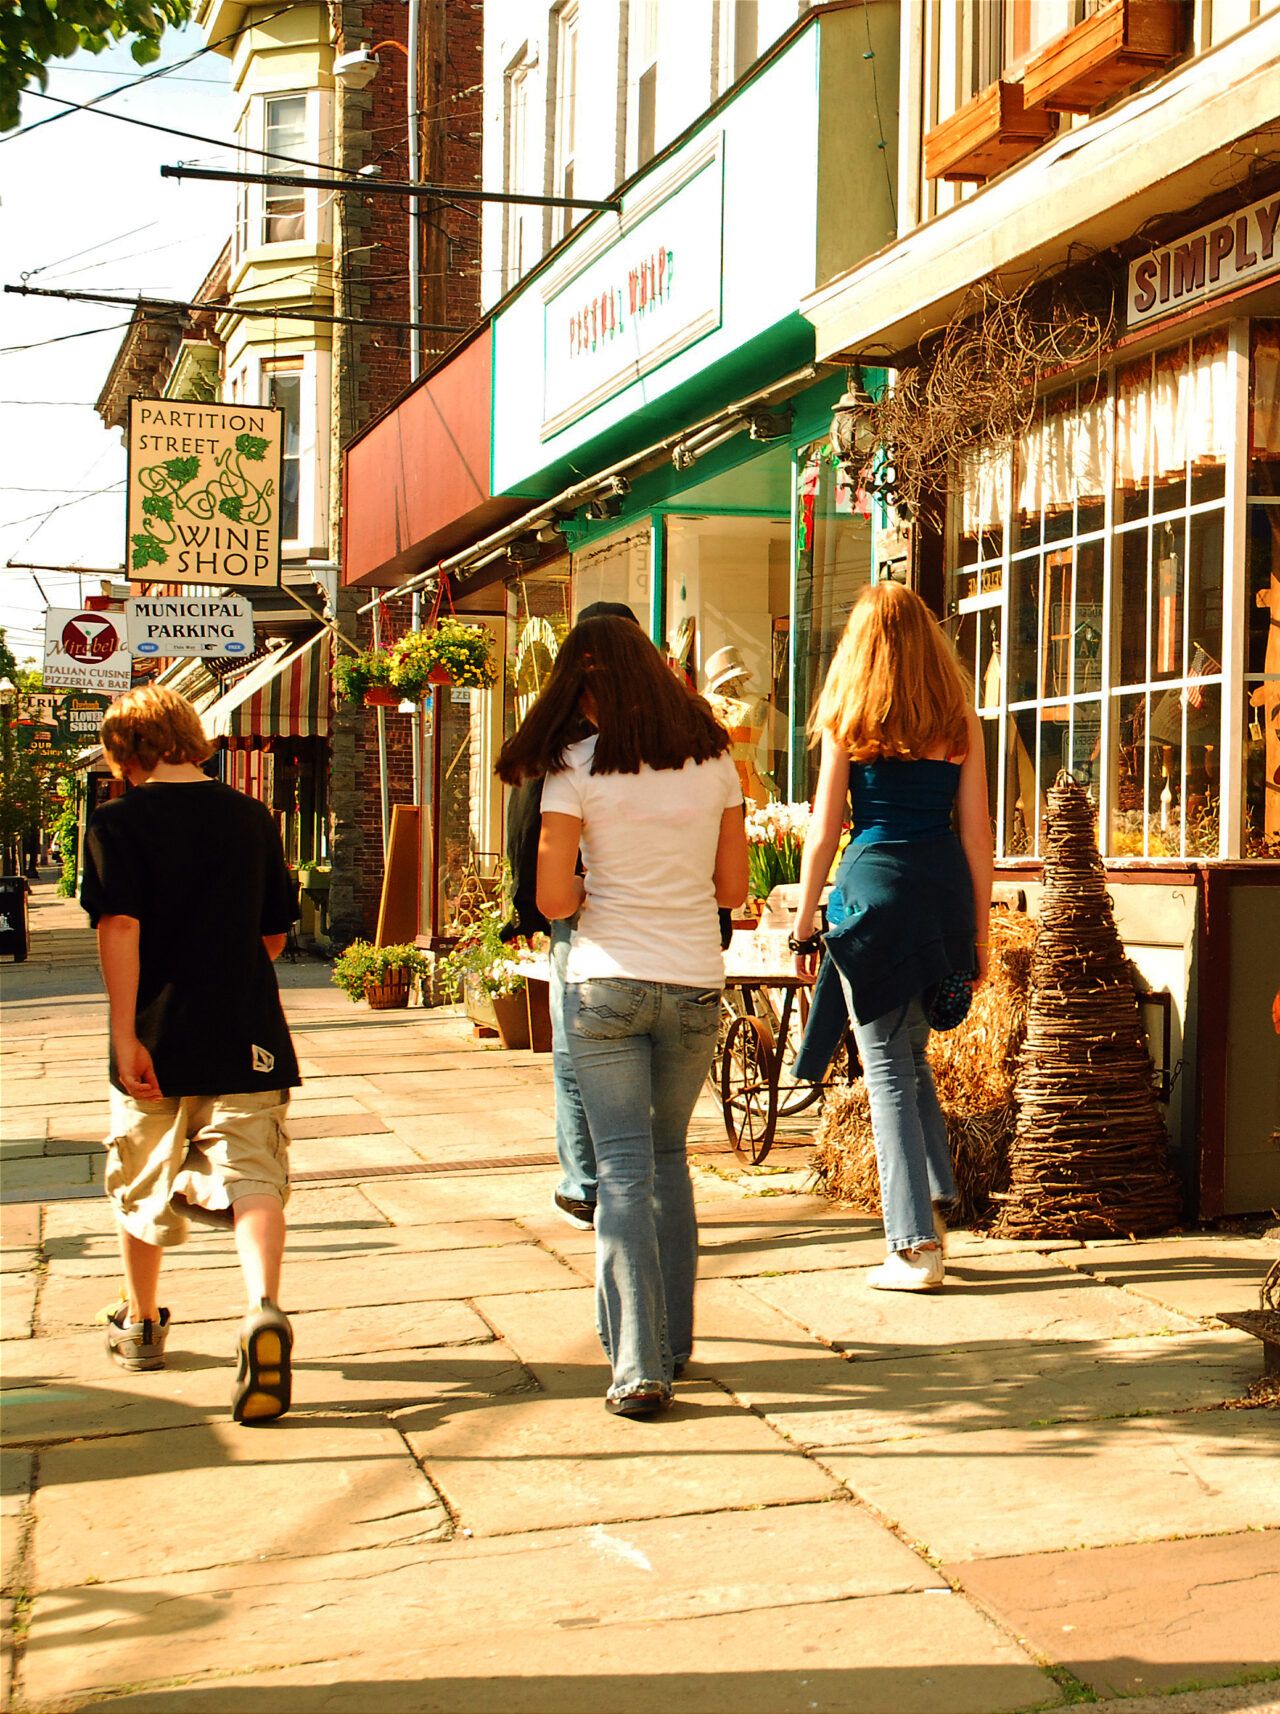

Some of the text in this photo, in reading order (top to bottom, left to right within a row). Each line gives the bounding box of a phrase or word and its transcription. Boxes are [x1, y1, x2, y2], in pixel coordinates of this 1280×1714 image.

[141, 408, 264, 432] PARTITION
[139, 435, 220, 455] STREET
[177, 525, 270, 552] WINE
[178, 551, 270, 577] SHOP
[136, 603, 244, 617] MUNICIPAL
[147, 624, 235, 638] PARKING
[44, 665, 130, 679] ITALIAN CUISINE
[45, 675, 129, 689] PIZZERIA & BAR
[70, 711, 104, 721] FLOWER
